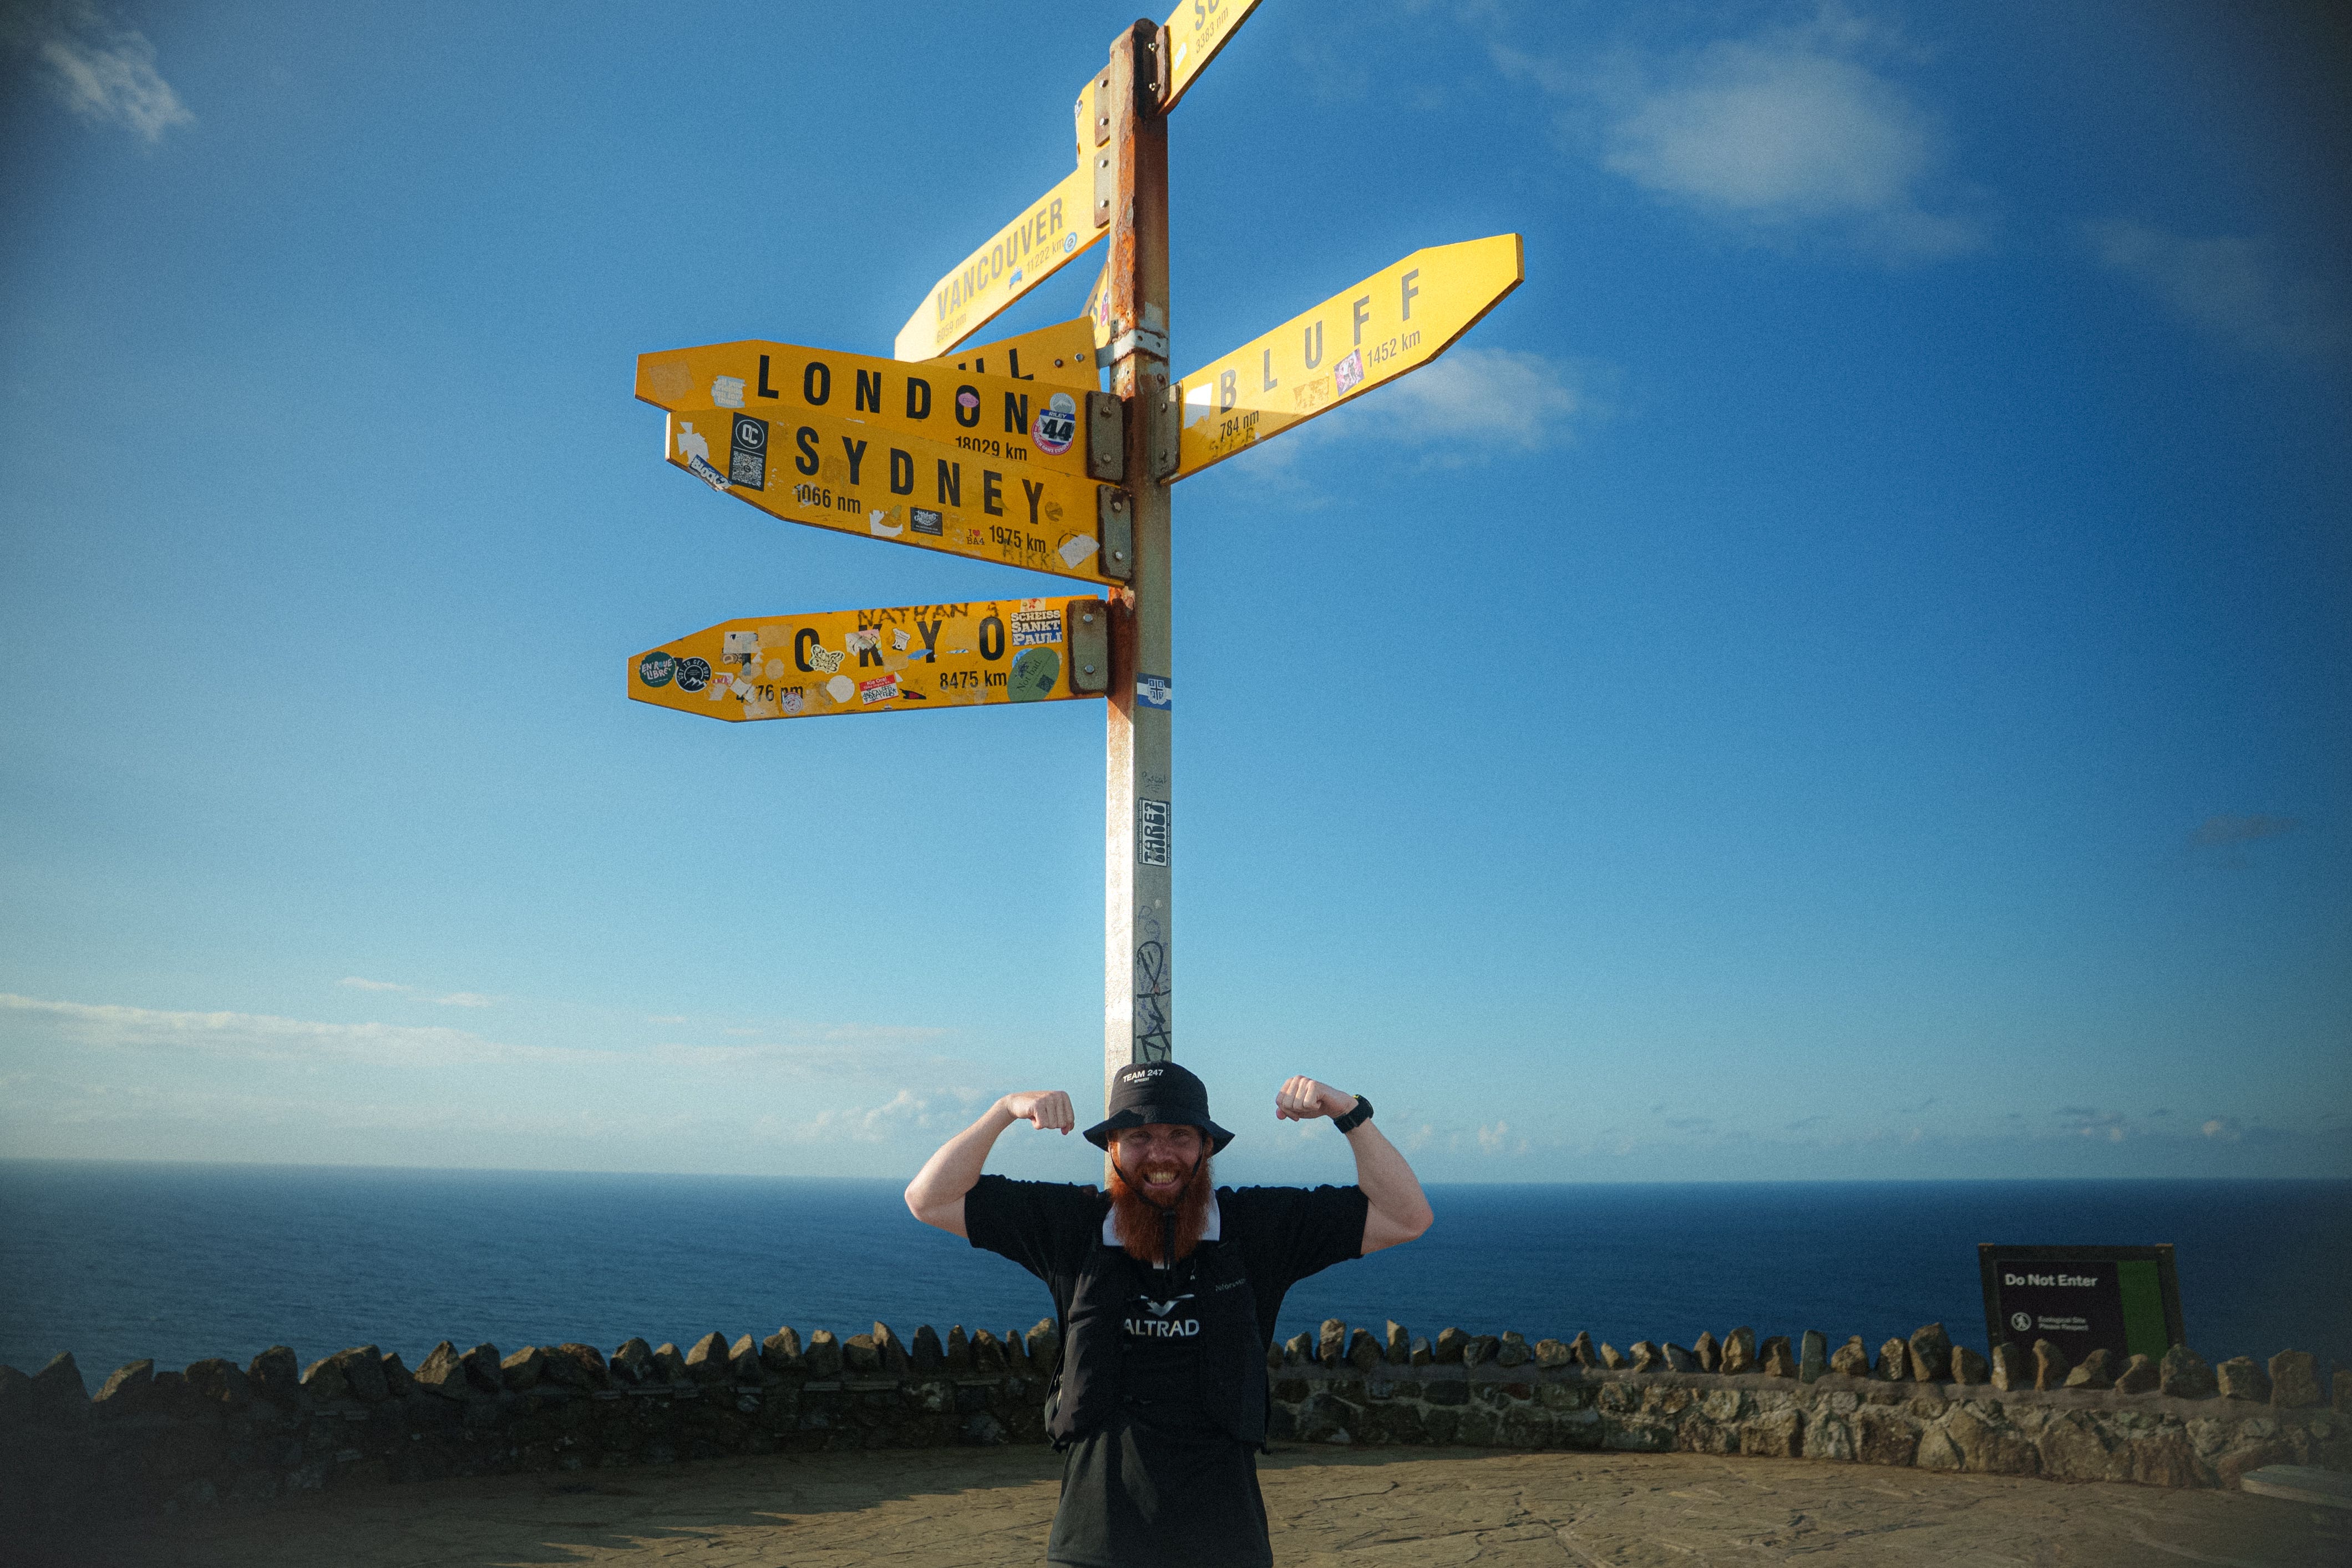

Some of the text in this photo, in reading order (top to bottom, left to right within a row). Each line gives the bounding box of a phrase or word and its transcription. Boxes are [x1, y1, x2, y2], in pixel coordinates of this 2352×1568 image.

[1196, 7, 1228, 53] 3383 nm
[937, 197, 1063, 321] VANCOUVER
[1026, 237, 1065, 273] 11222 km
[936, 313, 966, 342] 6059 nm
[1220, 268, 1419, 414] BLUFF
[1366, 330, 1421, 368] 1452 km
[758, 355, 1028, 435] LONDON
[1042, 419, 1072, 442] 44
[1220, 410, 1259, 440] 784 nm
[956, 436, 1027, 461] 18029 km
[795, 427, 1044, 525] SYDNEY
[794, 484, 861, 514] 1066 nm
[989, 525, 1046, 553] 1975 km
[1011, 610, 1061, 622] SCHEISS
[1011, 620, 1061, 633] SANKT
[1012, 632, 1063, 646] PAULI
[646, 668, 668, 680] LIBRE
[939, 669, 1007, 691] 8475 km
[1017, 677, 1030, 692] Not
[736, 684, 803, 704] 476 nm
[1123, 1070, 1145, 1083] TEAM
[2004, 1273, 2098, 1287] Do Not Enter
[1123, 1318, 1200, 1338] ALTRAD
